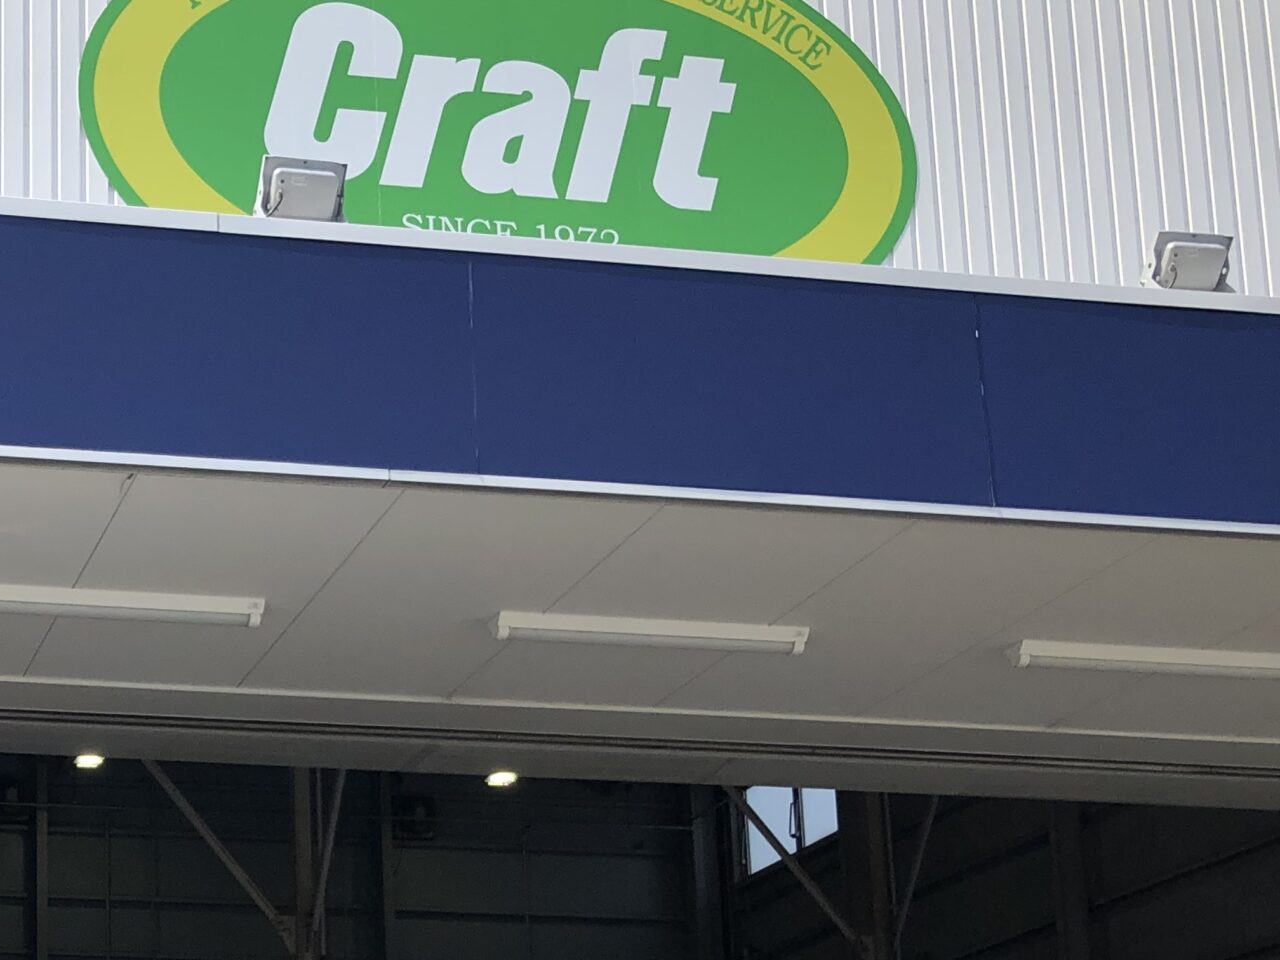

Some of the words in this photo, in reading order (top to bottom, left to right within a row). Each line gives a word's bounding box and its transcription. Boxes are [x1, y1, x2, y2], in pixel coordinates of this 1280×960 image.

[698, 0, 832, 70] ERVICE
[263, 2, 737, 212] Craft
[402, 213, 518, 237] SINCE
